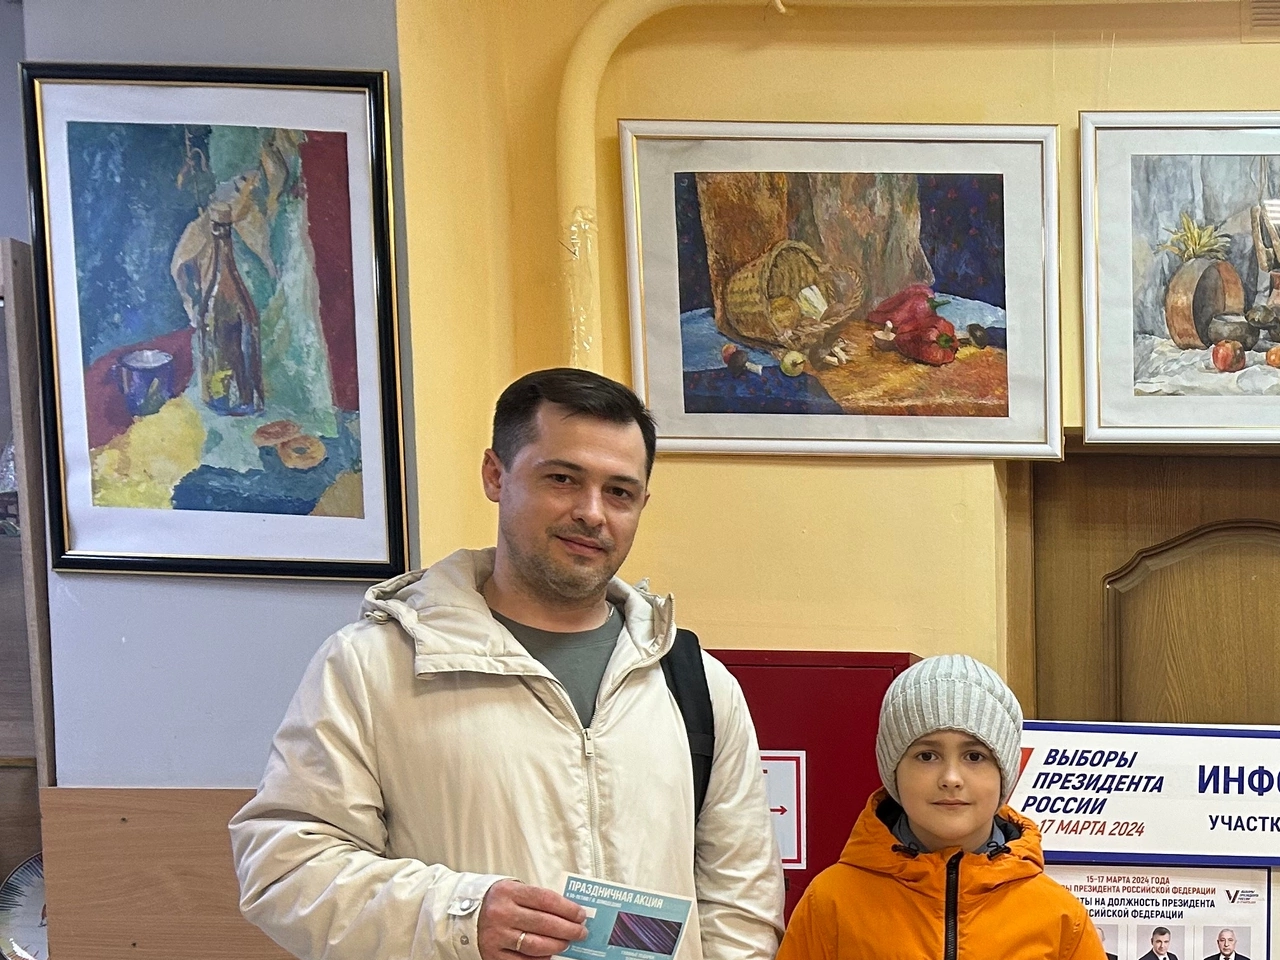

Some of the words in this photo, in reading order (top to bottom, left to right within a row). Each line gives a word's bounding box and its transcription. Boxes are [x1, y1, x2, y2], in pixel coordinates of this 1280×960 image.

[1043, 748, 1138, 768] ВЫБОРЫ
[1032, 772, 1165, 794] ПРЕЗИДЕНТА
[1020, 796, 1108, 815] РОССИИ
[1037, 819, 1056, 834] 17
[1055, 820, 1107, 836] МАРТА
[1108, 821, 1145, 837] 2024
[1086, 875, 1104, 883] 15-17
[1106, 876, 1130, 884] МАРТА
[1132, 876, 1150, 884] 2024
[1151, 877, 1170, 885] ГОДА
[568, 880, 633, 903] ПРАЗДНИЧНАЯ
[633, 896, 664, 909] АКЦИЯ
[1074, 885, 1120, 894] ПРЕЗИДЕНТА
[1122, 884, 1170, 894] РОССИЙСКОЙ
[1171, 886, 1216, 895] ФЕДЕРАЦИИ
[1094, 898, 1106, 906] НА
[1107, 899, 1160, 908] ДОЛЖНОСТЬ
[1162, 899, 1216, 909] ПРЕЗИДЕНТА
[1088, 907, 1129, 918] СИЙСКОЙ
[1131, 909, 1184, 919] ФЕДЕРАЦИИ
